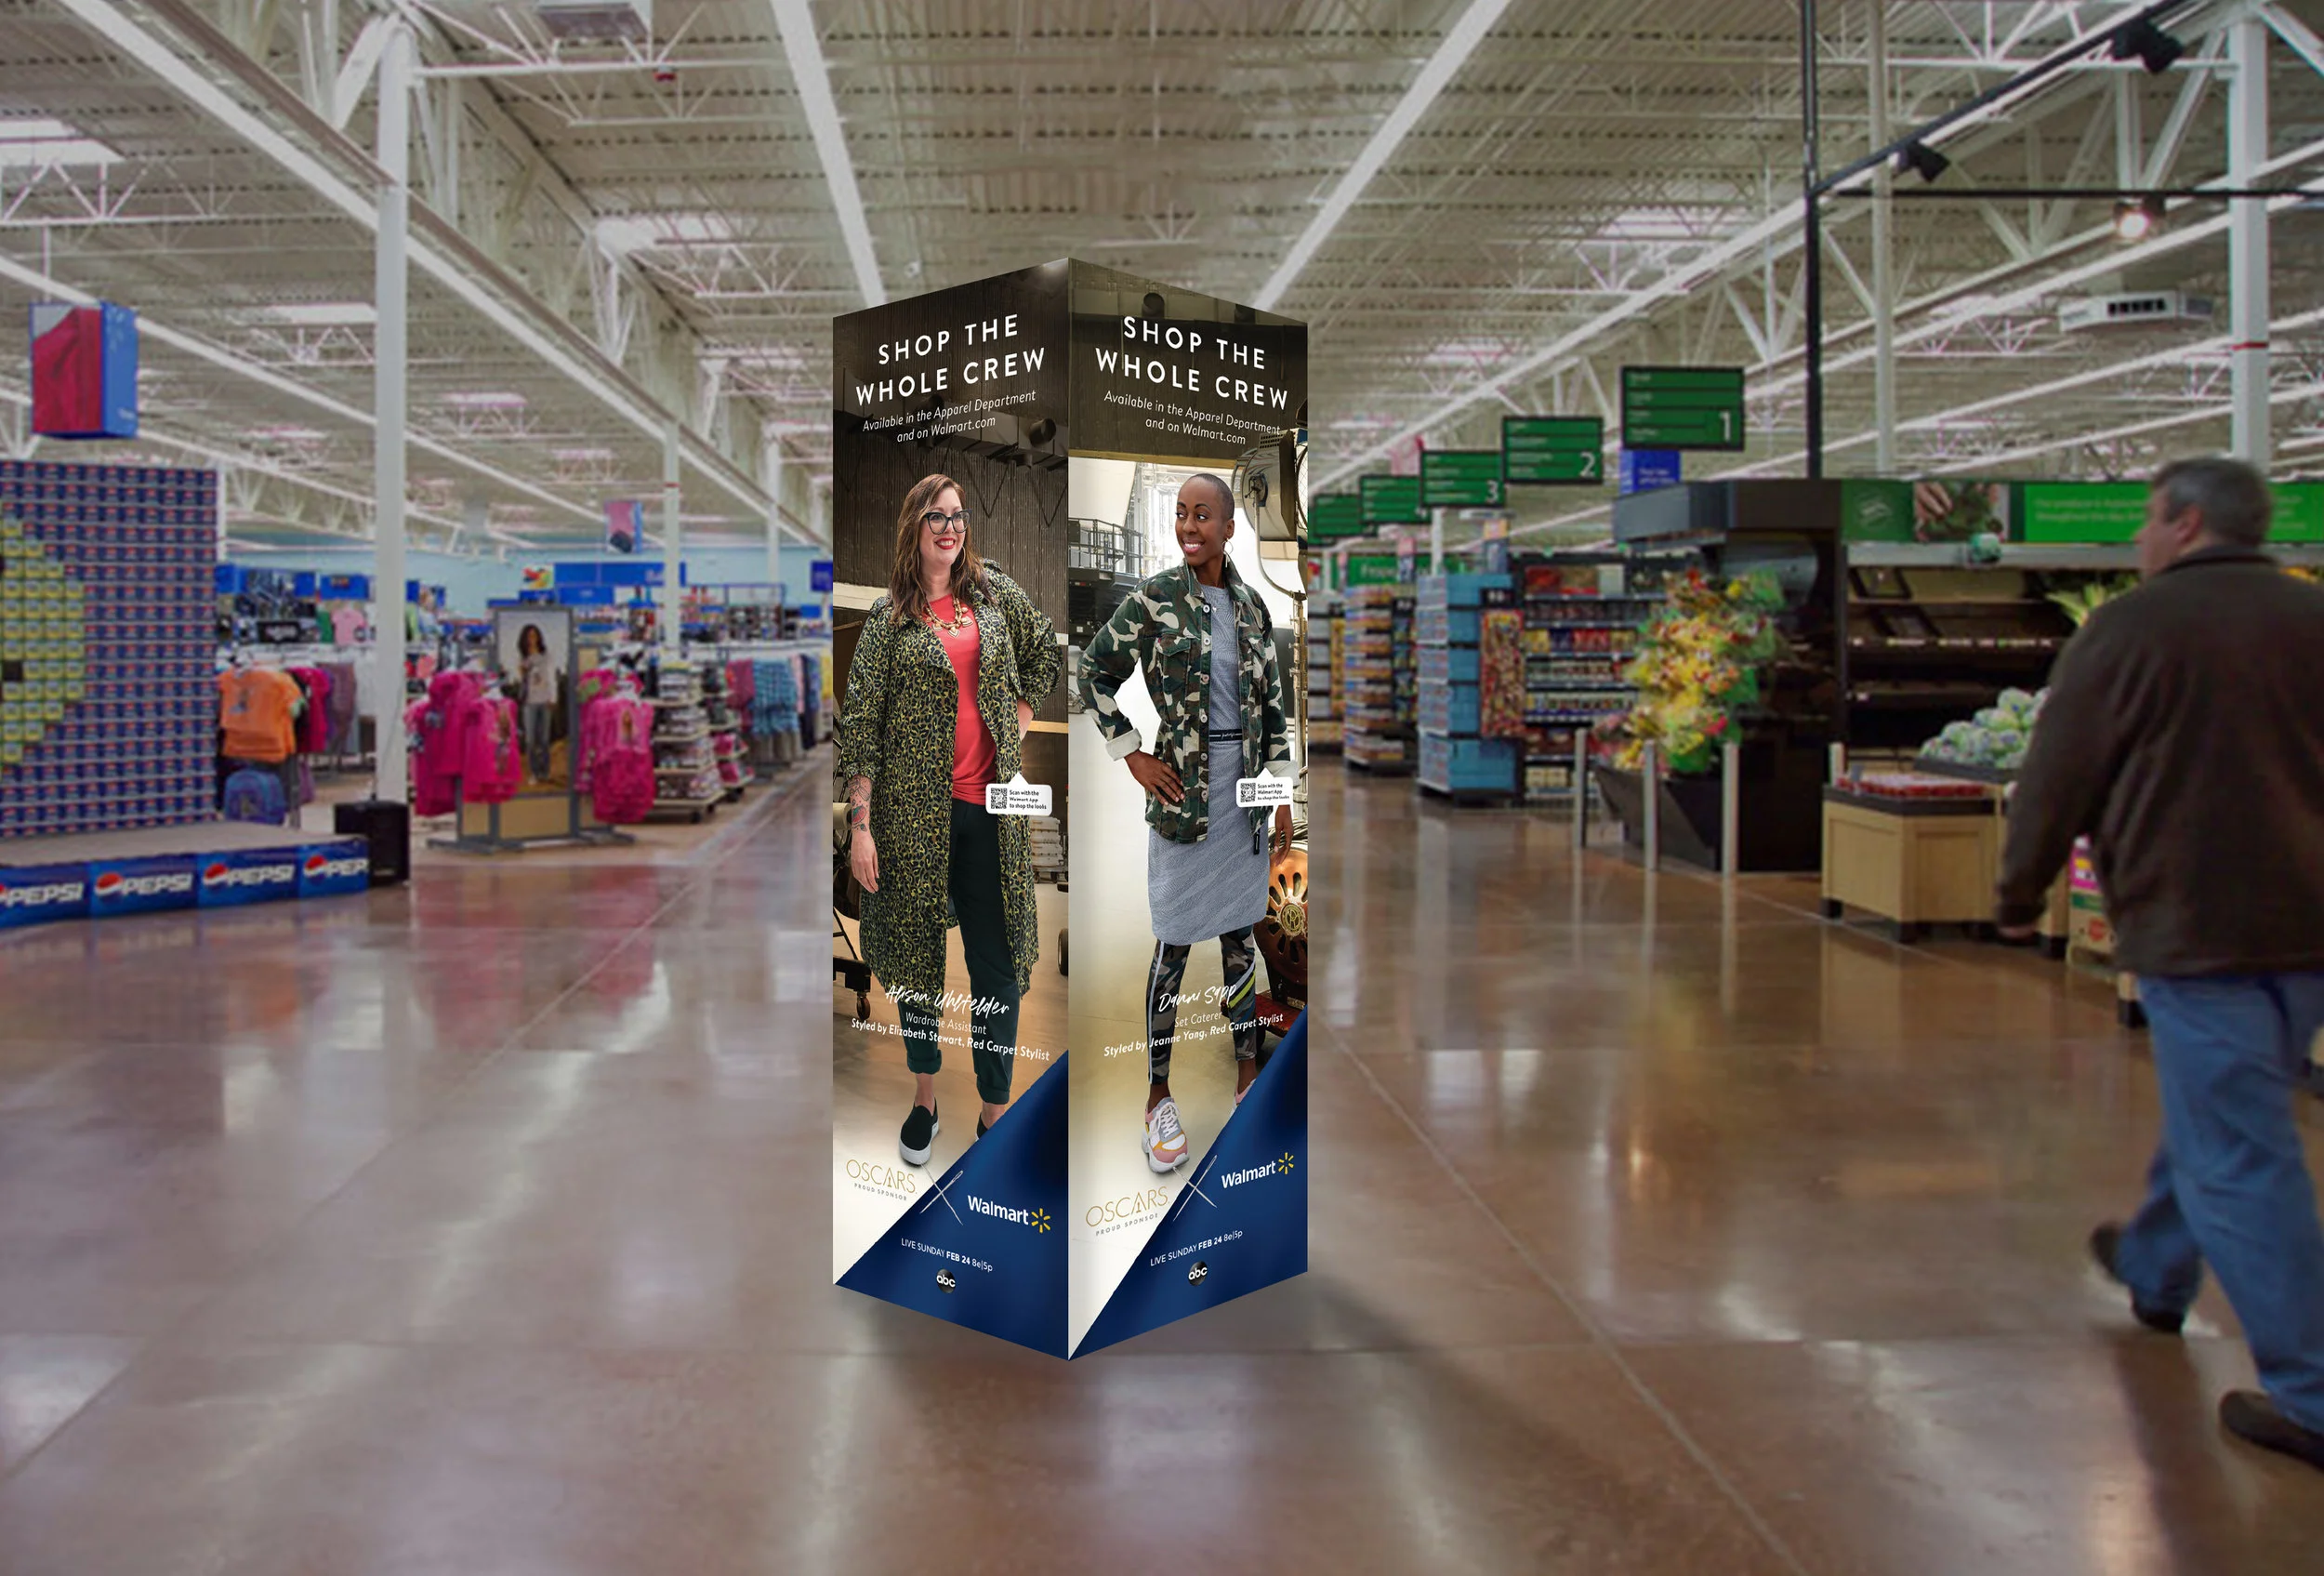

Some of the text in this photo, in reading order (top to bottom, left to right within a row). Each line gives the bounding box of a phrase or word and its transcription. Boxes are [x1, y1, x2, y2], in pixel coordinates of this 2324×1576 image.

[878, 313, 1018, 365] SHOP THE
[1123, 316, 1265, 370] SHOP THE
[856, 347, 1045, 406] WHOLE CREW
[1095, 348, 1287, 410] WHOLE CREW
[863, 390, 1037, 432] Available in the Apparel Department
[1103, 391, 1280, 435] Available in the Apparel Department
[897, 417, 996, 443] and on Walmart.com
[1145, 417, 1246, 445] and on Walmart.com
[1719, 411, 1730, 442] 1
[1579, 451, 1595, 477] 2
[1487, 480, 1499, 504] 3
[227, 864, 295, 887] PEPSI
[325, 858, 369, 878] PEP
[7, 881, 84, 907] PEPSI
[121, 873, 193, 895] PEPSI
[905, 1012, 987, 1035] Wardrobe Assistant
[1174, 1012, 1222, 1027] Set Caterer
[852, 1018, 1050, 1061] Styled by Elizabeth Stewart, Red Carpet Stylist
[1103, 1013, 1284, 1058] Styled by Jeanne Yang, Red Carpet Stylist
[846, 1159, 916, 1194] OSCARS
[1221, 1160, 1276, 1189] Walmart
[854, 1183, 906, 1200] PROUD SPONSOR
[968, 1195, 1029, 1225] Walmart
[1086, 1185, 1169, 1227] OSCARS
[1096, 1212, 1158, 1236] PROUD SPONSOR
[901, 1238, 917, 1250] LIVE
[917, 1242, 945, 1258] SUNDAY
[946, 1251, 960, 1262] FEB
[961, 1255, 971, 1265] 24
[1150, 1253, 1167, 1266] LIVE
[1168, 1243, 1198, 1261] SUNDAY
[1198, 1238, 1212, 1251] FEB
[1213, 1236, 1222, 1246] 24
[936, 1273, 956, 1289] abc
[1188, 1265, 1208, 1281] abc
